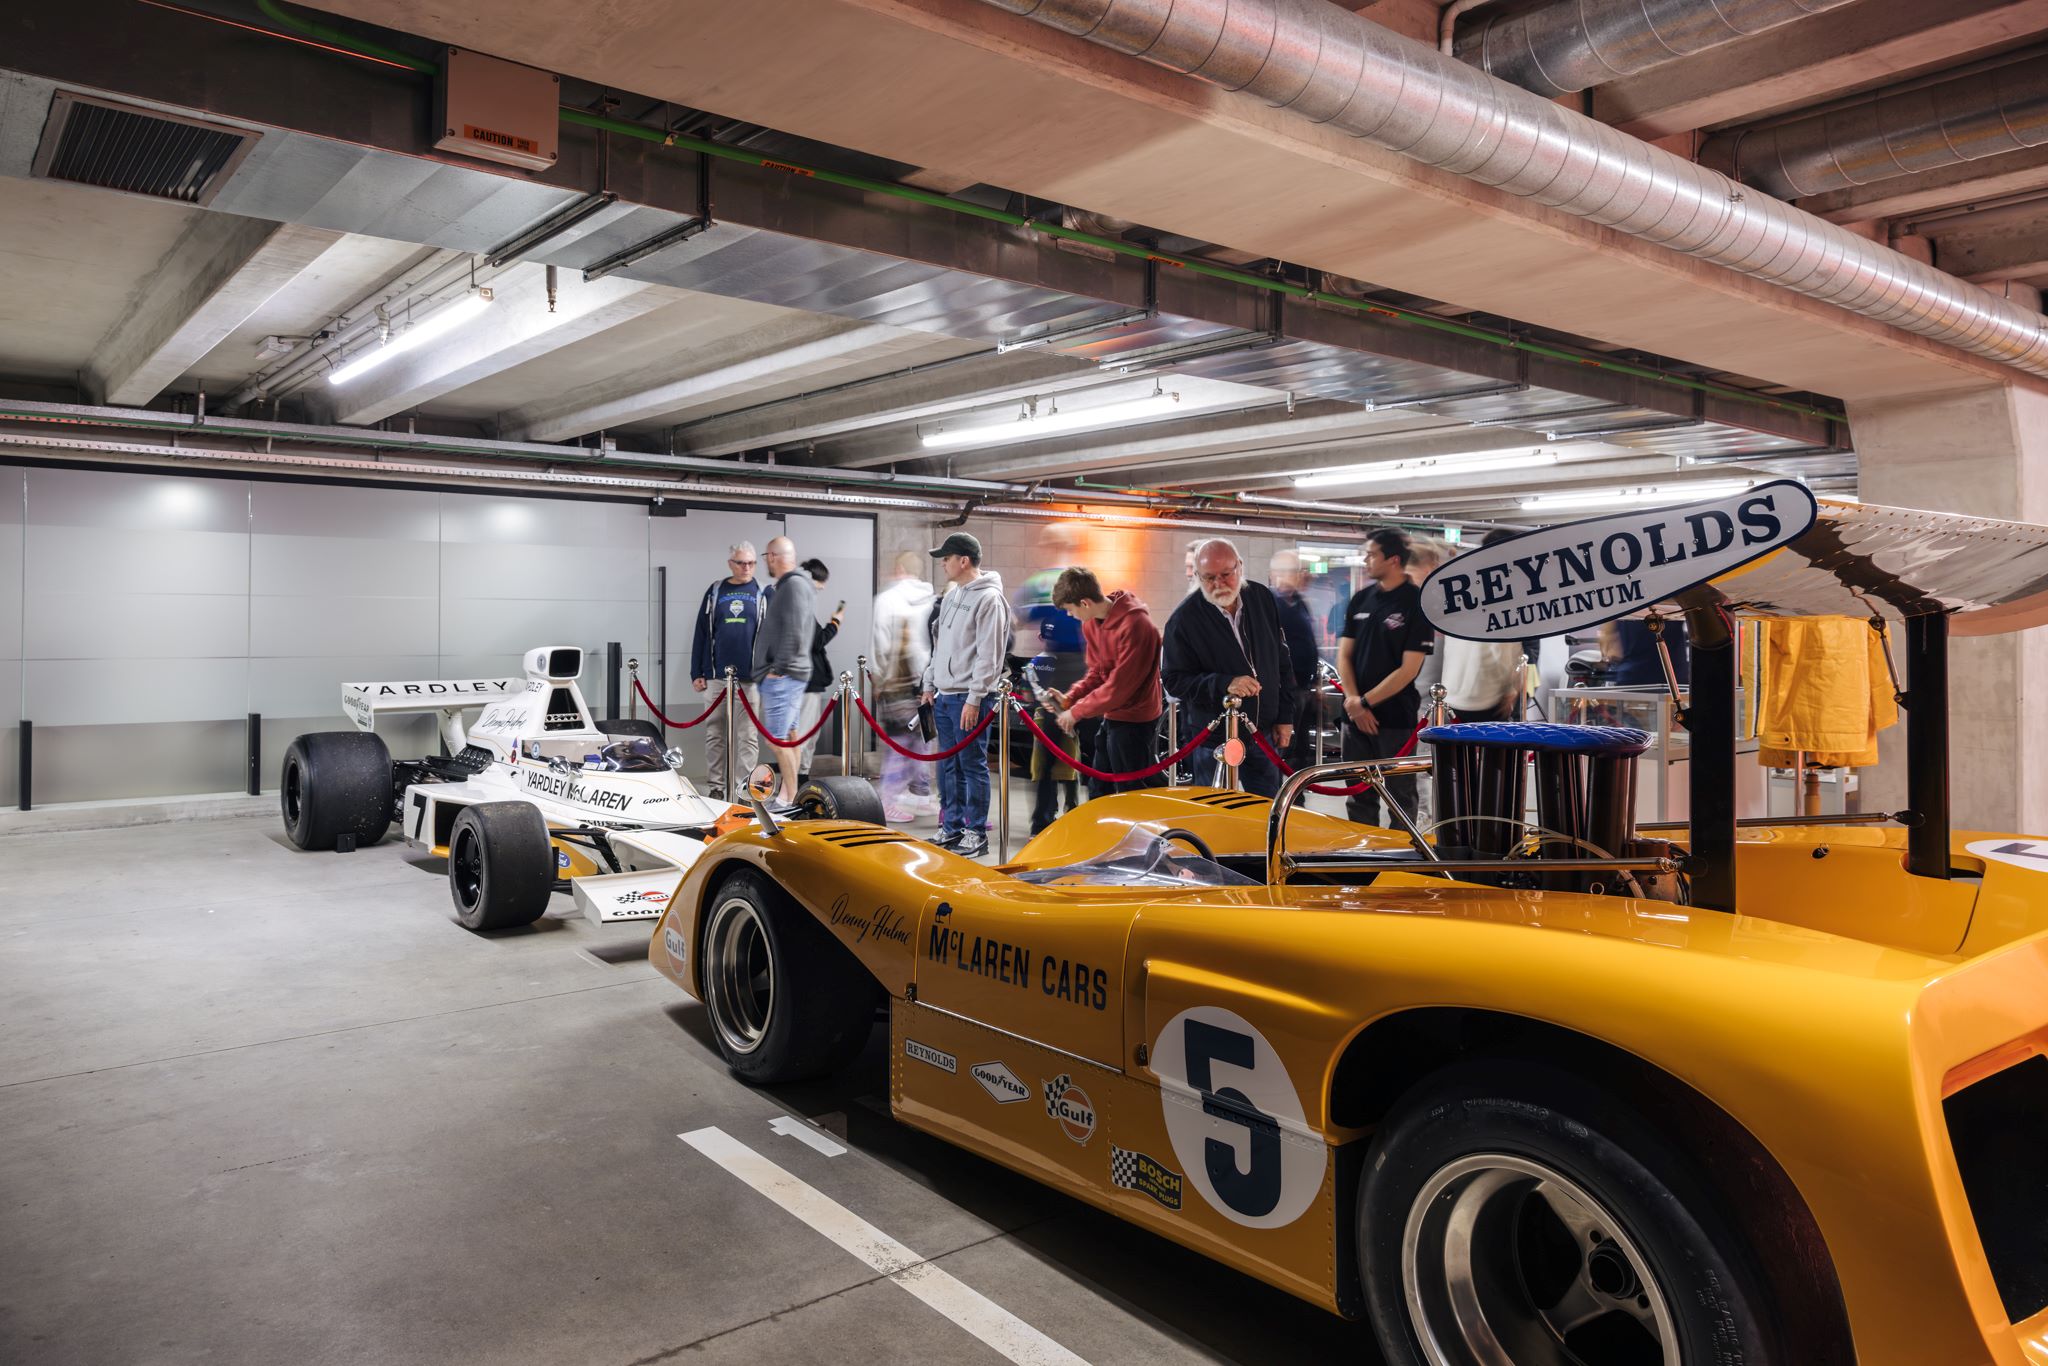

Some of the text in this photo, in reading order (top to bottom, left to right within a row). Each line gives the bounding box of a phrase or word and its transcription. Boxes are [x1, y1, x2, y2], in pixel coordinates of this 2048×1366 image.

[473, 128, 514, 147] CAUTION
[1438, 494, 1782, 615] REYNOLDS
[1485, 579, 1645, 633] ALUMINUM
[353, 681, 508, 697] YARDLEY
[526, 770, 567, 796] YARDLEY
[412, 791, 428, 841] 7
[831, 893, 911, 945] Denny Hulme
[665, 930, 685, 960] Gulf
[1041, 955, 1107, 1011] CARS
[907, 1042, 955, 1071] REYNOLDS
[974, 1067, 1026, 1096] GOODYEAR
[1059, 1101, 1094, 1126] Gulf
[1184, 1018, 1282, 1217] 5
[1138, 1159, 1180, 1192] BOSCH
[1158, 1191, 1179, 1206] PLUGS
